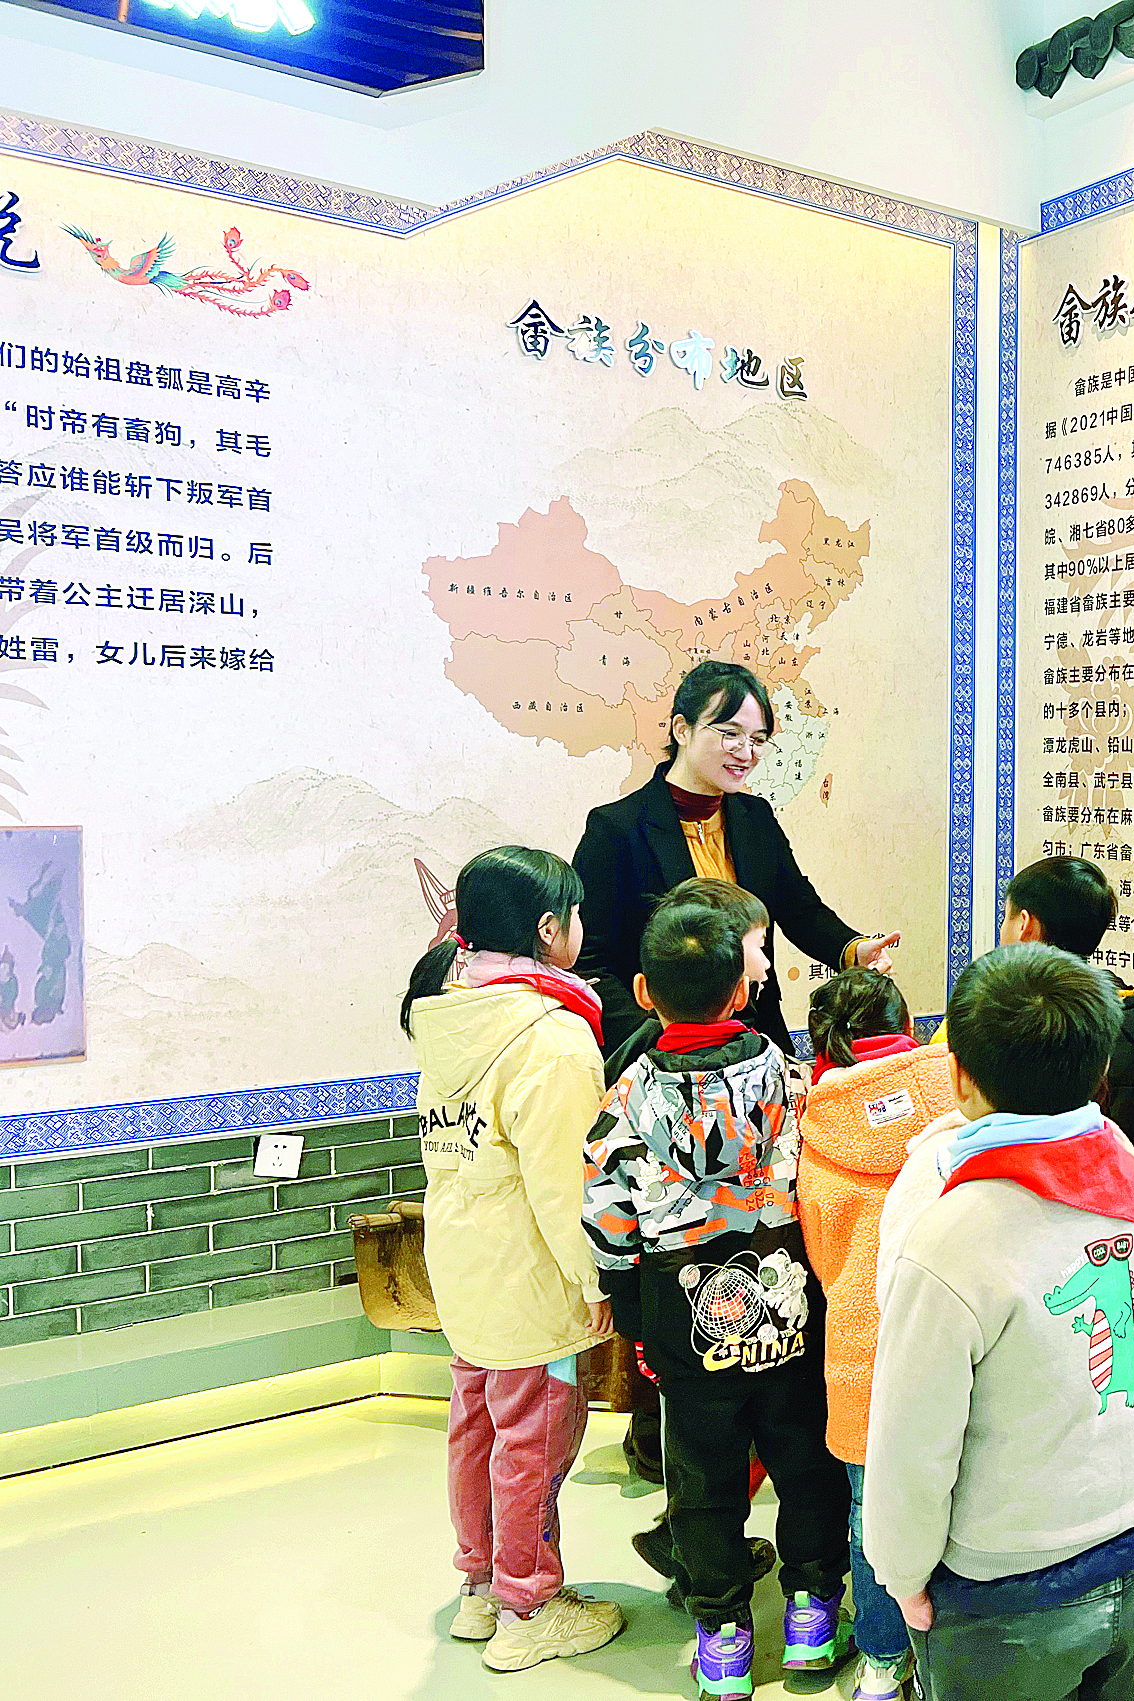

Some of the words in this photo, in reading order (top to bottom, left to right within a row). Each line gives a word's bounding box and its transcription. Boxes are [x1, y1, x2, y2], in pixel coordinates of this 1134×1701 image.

[507, 299, 808, 400] 畲族分布地区
[822, 537, 856, 548] 黑龙江
[824, 576, 846, 587] 吉林
[447, 582, 573, 603] 新疆维吾尔自治区
[693, 582, 774, 627] 内蒙古自治区
[806, 599, 826, 610] 辽宁
[768, 613, 791, 625] 北京
[780, 631, 800, 642] 天津
[743, 639, 751, 662] 山西
[761, 634, 770, 657] 河北
[598, 654, 632, 667] 青海
[778, 656, 799, 668] 山东
[511, 701, 585, 714] 西藏自治区
